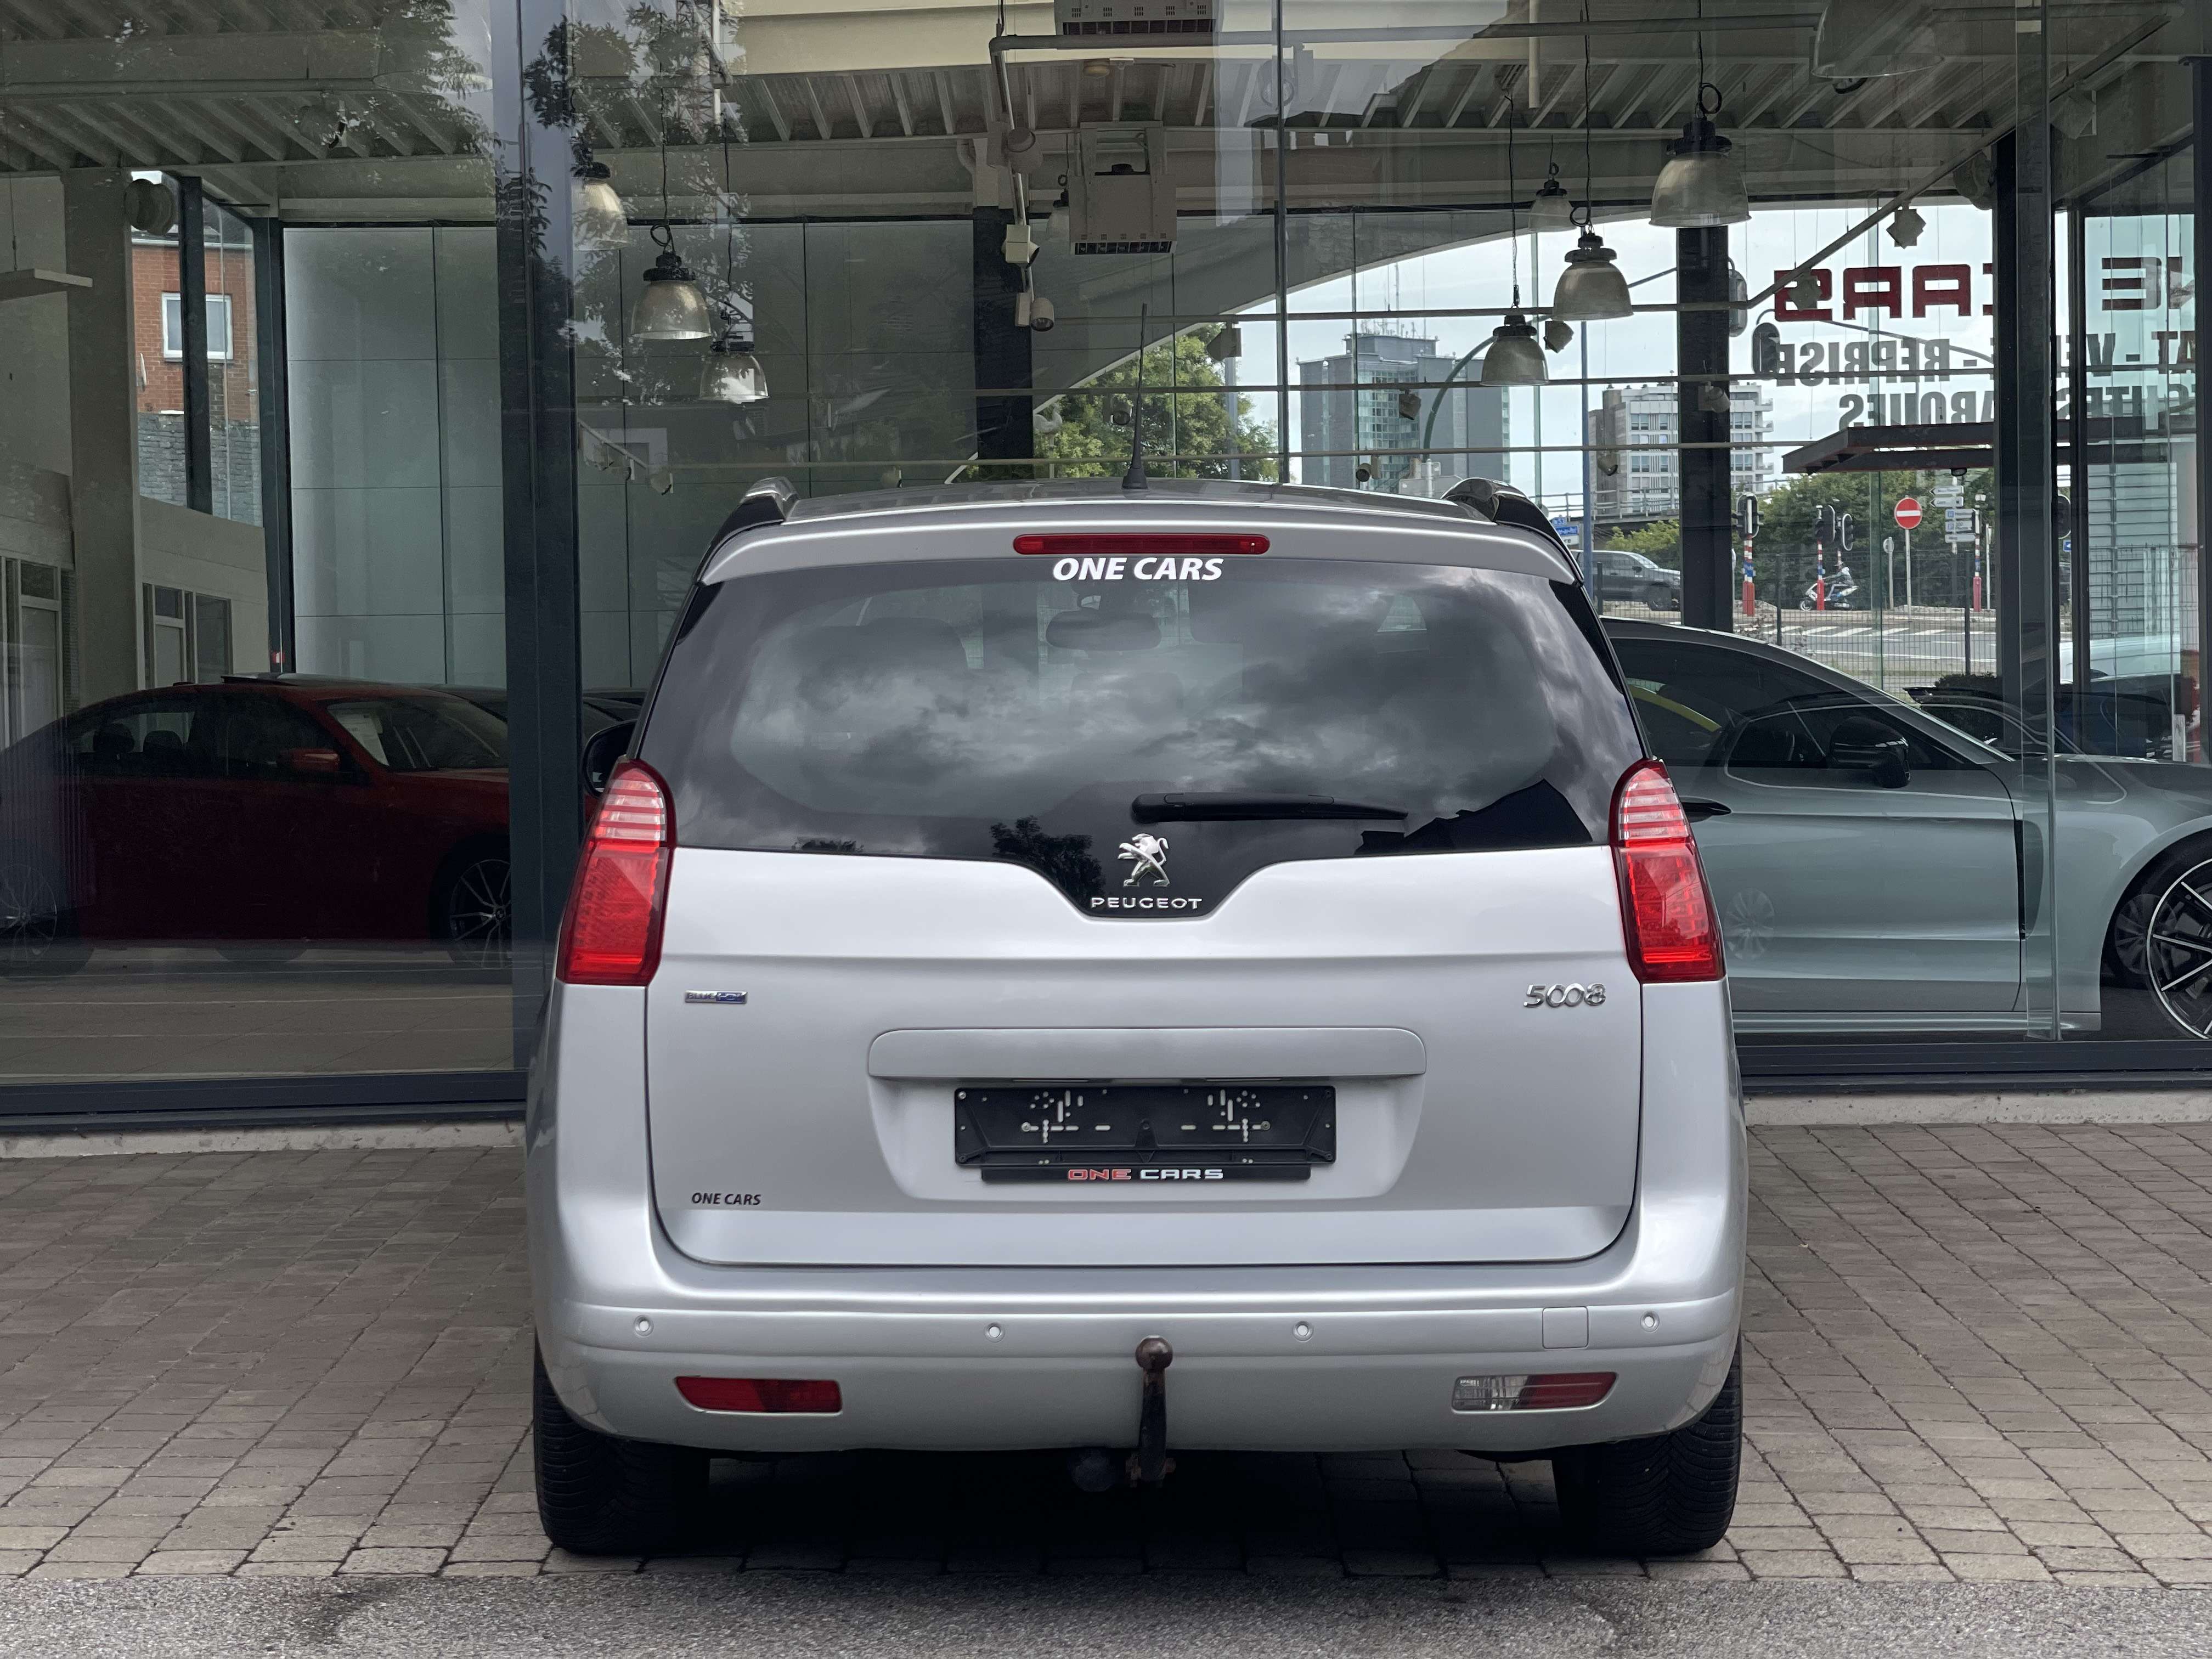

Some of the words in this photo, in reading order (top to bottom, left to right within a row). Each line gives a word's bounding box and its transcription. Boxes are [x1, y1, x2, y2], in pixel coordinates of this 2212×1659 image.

[1053, 557, 1127, 580] ONE
[1133, 557, 1224, 580] CARS
[1091, 897, 1203, 909] PEUGEOT
[1523, 983, 1606, 1008] 5008
[1068, 1169, 1132, 1180] ONE
[1140, 1169, 1223, 1180] CARS
[692, 1192, 721, 1204] ONE
[724, 1193, 761, 1205] CARS
